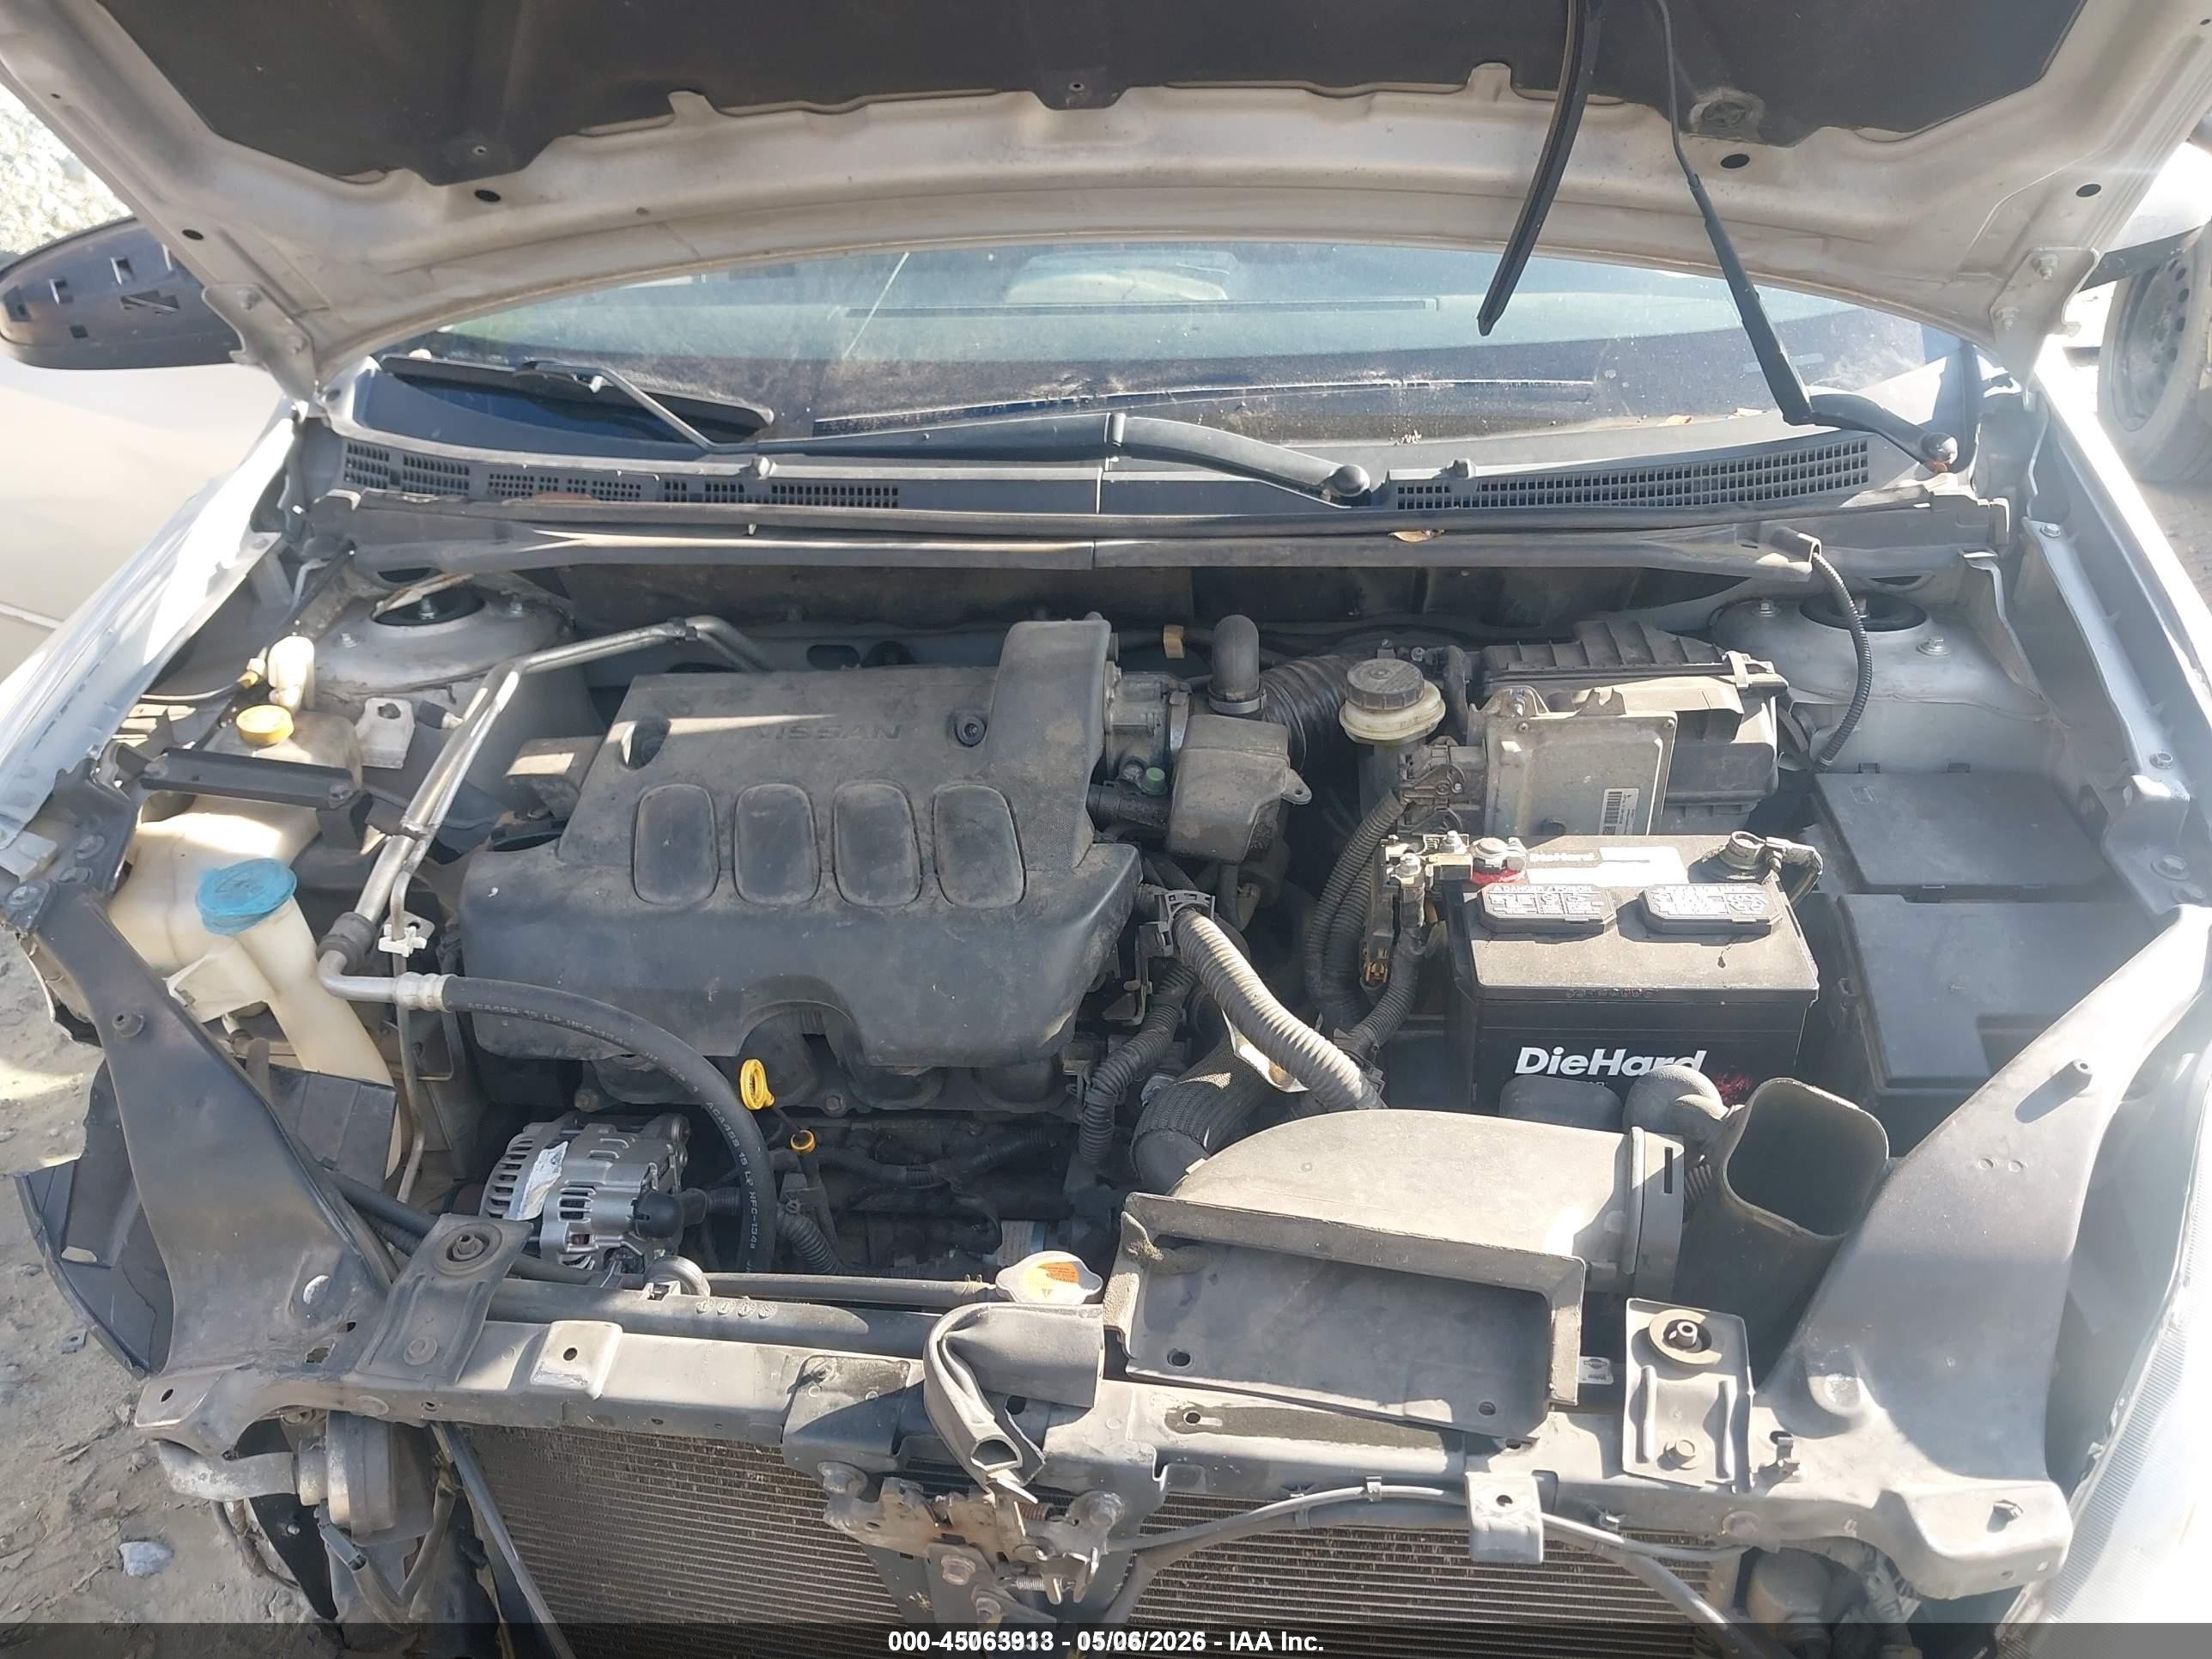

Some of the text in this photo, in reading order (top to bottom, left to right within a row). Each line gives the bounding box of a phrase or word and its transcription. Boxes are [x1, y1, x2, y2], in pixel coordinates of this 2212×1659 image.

[1529, 852, 1595, 862] DieHard
[1515, 1046, 1708, 1076] DieHard
[744, 1170, 754, 1187] LP
